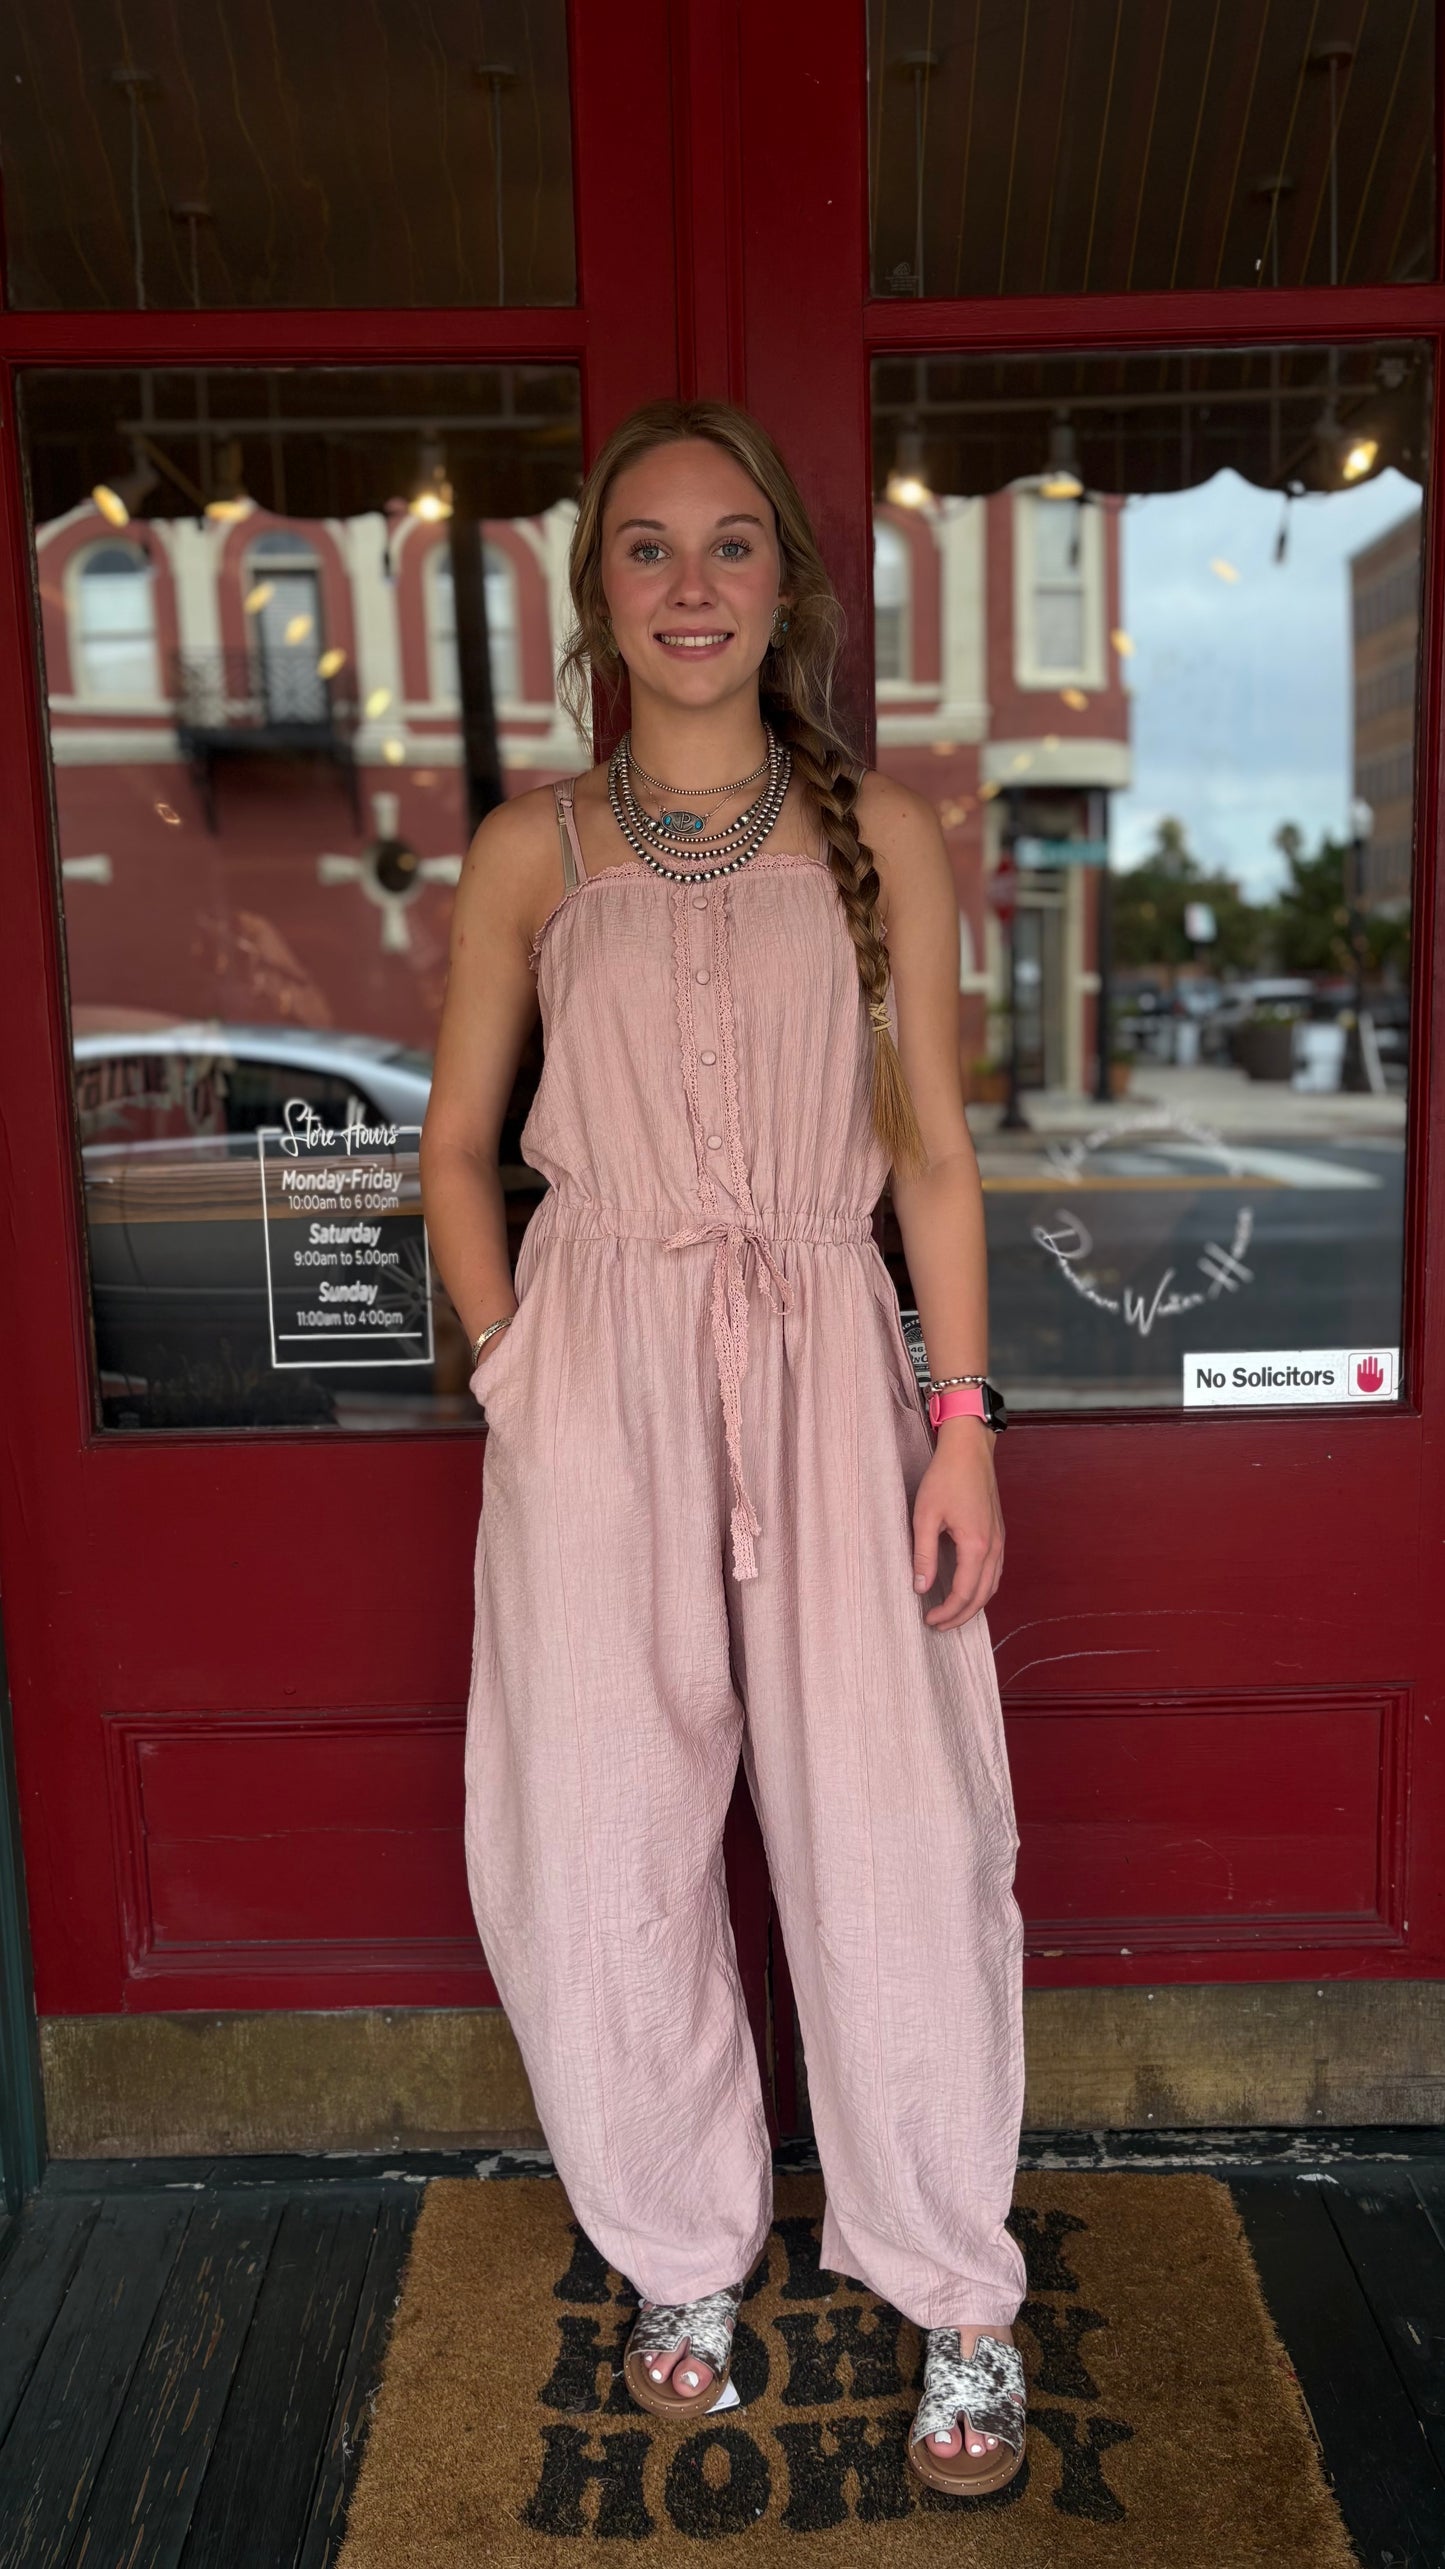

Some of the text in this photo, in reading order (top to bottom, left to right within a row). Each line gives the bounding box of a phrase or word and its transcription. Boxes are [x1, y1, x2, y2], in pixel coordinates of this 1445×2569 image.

[280, 1096, 399, 1157] Store Hours
[281, 1167, 402, 1194] Monday-Friday
[288, 1194, 337, 1210] 10:00am
[340, 1196, 352, 1209] to
[308, 1222, 381, 1247] Saturday
[294, 1250, 338, 1266] 9:00am
[340, 1251, 353, 1265] to
[318, 1280, 378, 1305] Sunday
[343, 1311, 356, 1325] to
[1196, 1366, 1335, 1388] No Solicitors
